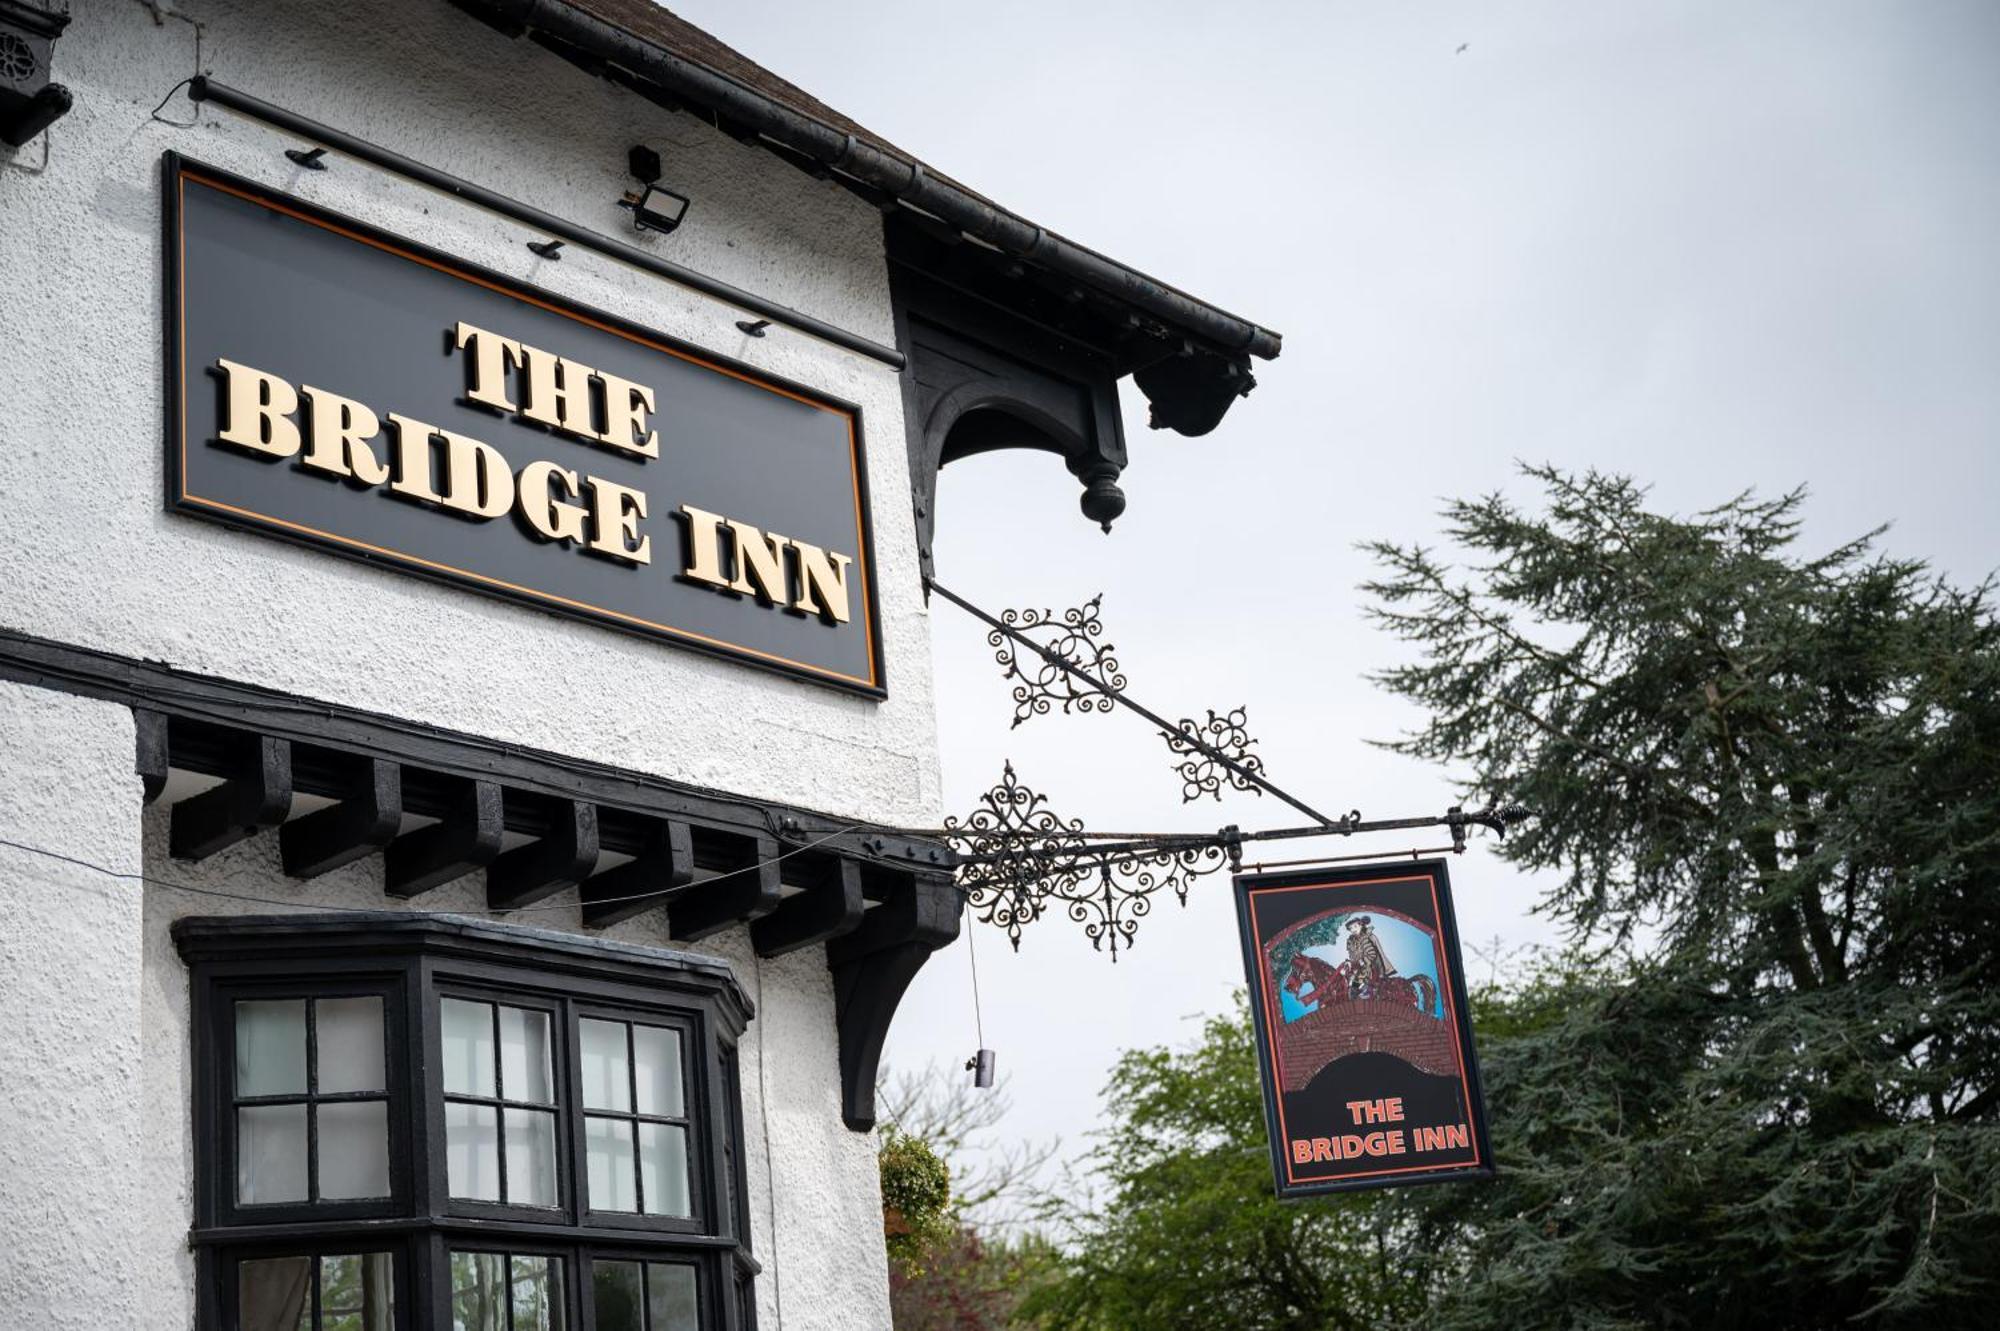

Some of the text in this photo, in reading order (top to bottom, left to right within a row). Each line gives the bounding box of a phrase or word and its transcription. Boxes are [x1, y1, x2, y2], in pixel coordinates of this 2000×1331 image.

[456, 321, 660, 459] THE
[217, 358, 851, 624] BRIDGE INN
[1292, 1124, 1469, 1164] BRIDGE INN
[1346, 1097, 1404, 1125] THE
